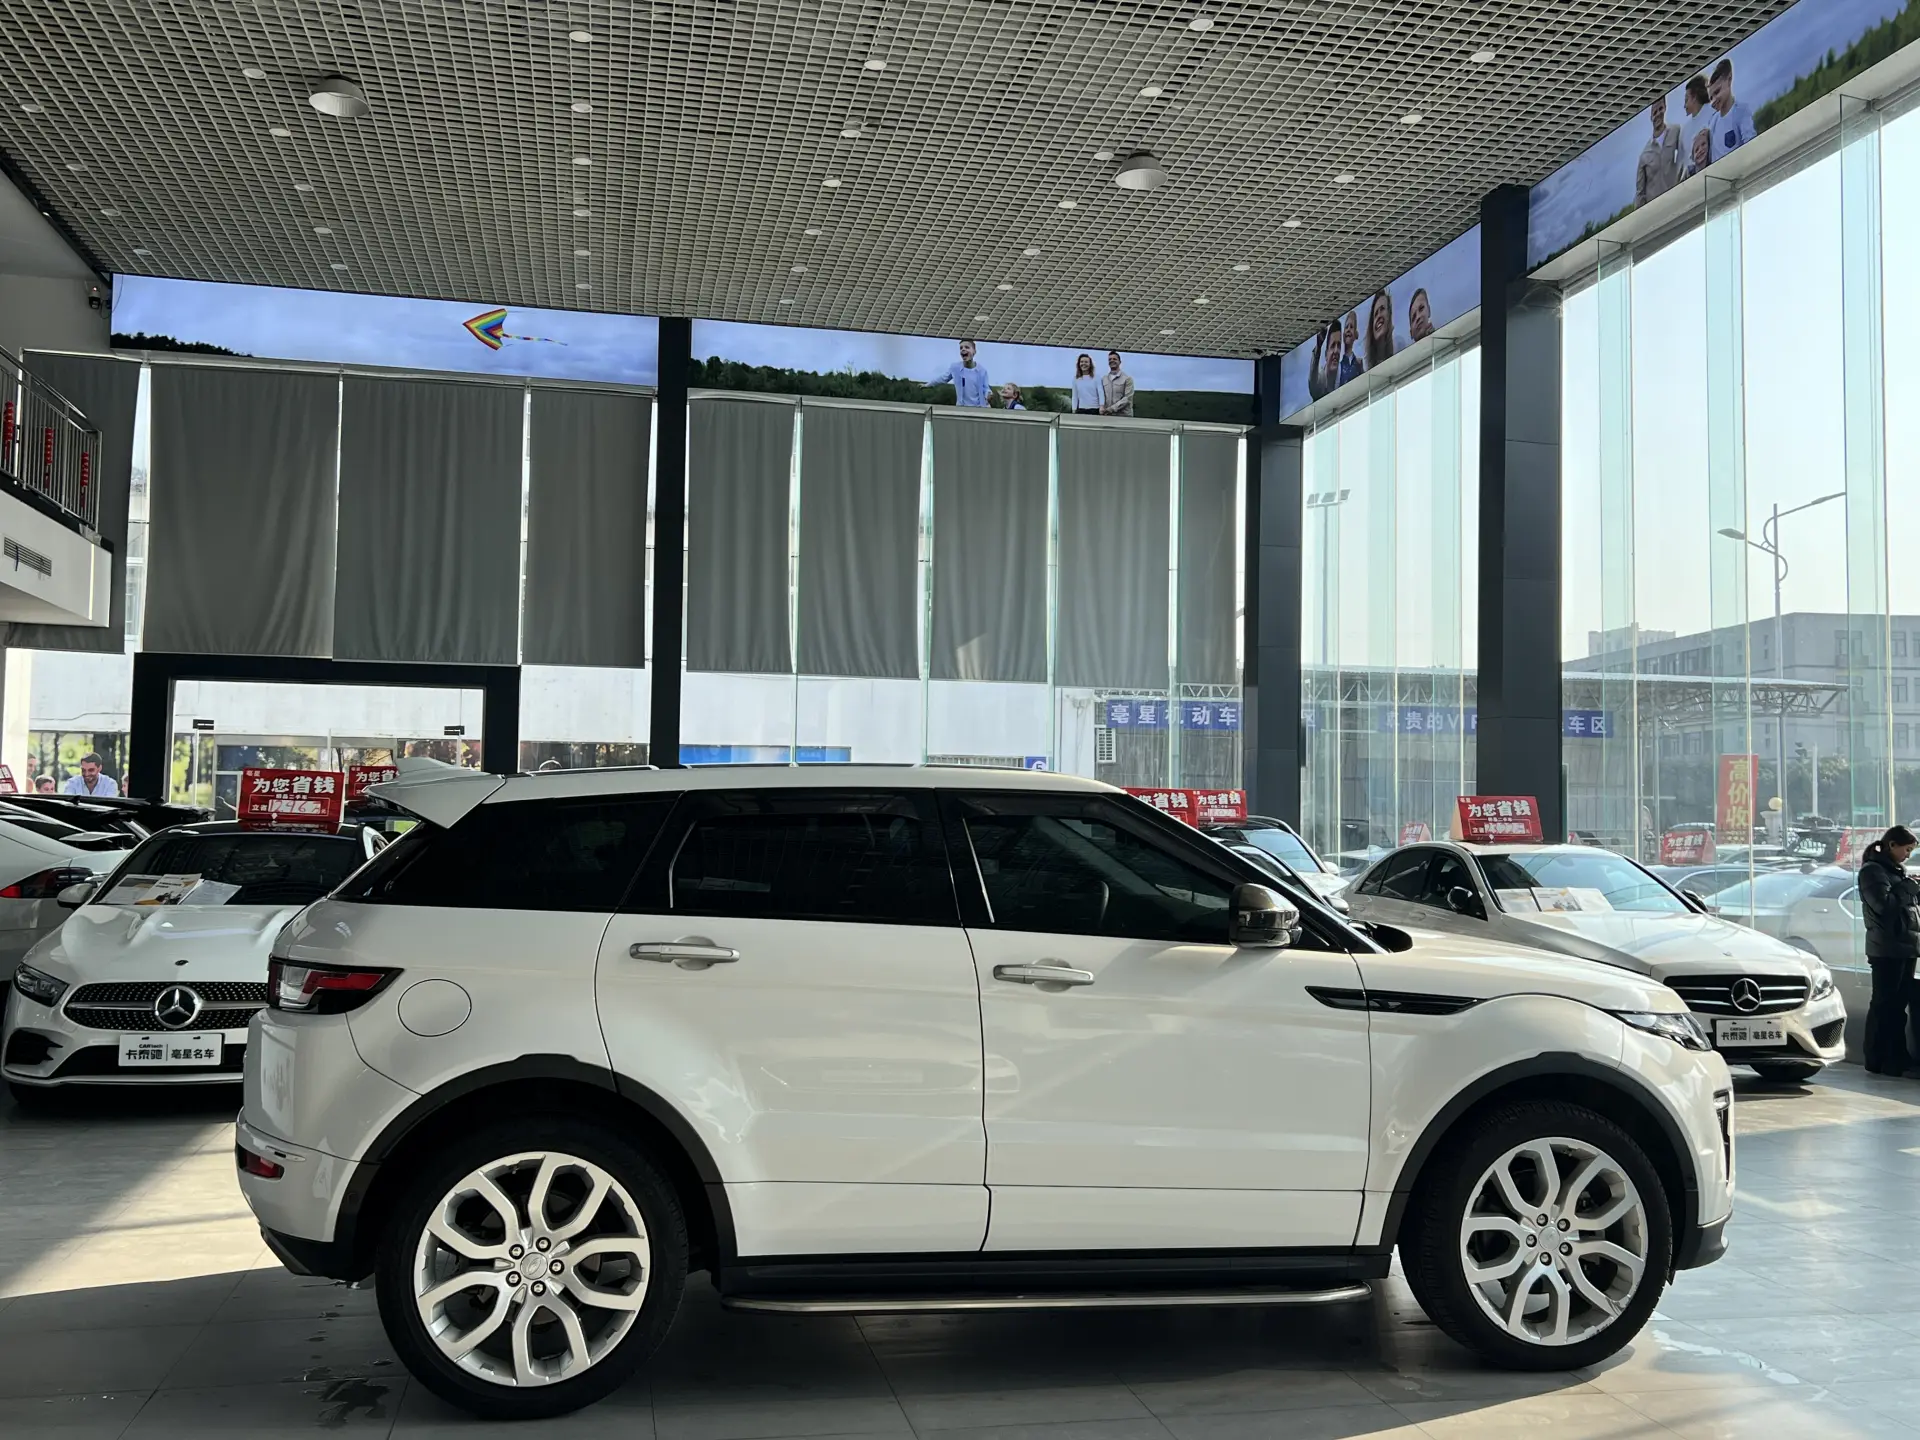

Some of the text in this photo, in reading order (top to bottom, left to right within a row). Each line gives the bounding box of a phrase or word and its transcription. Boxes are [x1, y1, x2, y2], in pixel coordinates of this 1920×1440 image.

[1568, 716, 1606, 733] 车区
[252, 776, 335, 793] 为您省钱
[1468, 800, 1531, 817] 为您省钱
